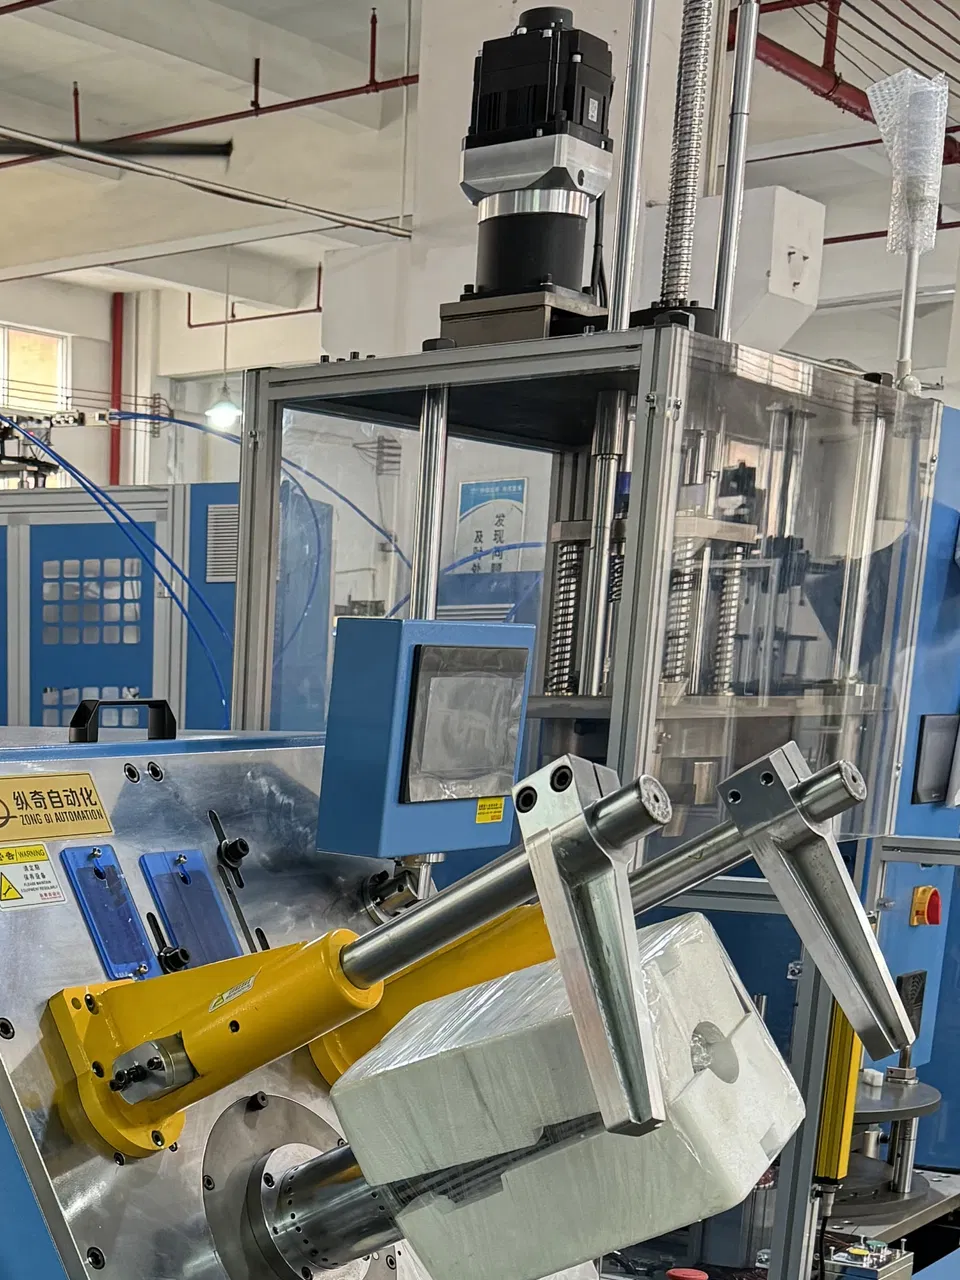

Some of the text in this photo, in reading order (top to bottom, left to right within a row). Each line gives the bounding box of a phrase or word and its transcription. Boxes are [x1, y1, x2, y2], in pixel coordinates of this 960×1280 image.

[13, 786, 97, 811] 纵奇自动化
[20, 809, 104, 826] ZONG QI AUTOMATION
[17, 849, 45, 859] WARNING
